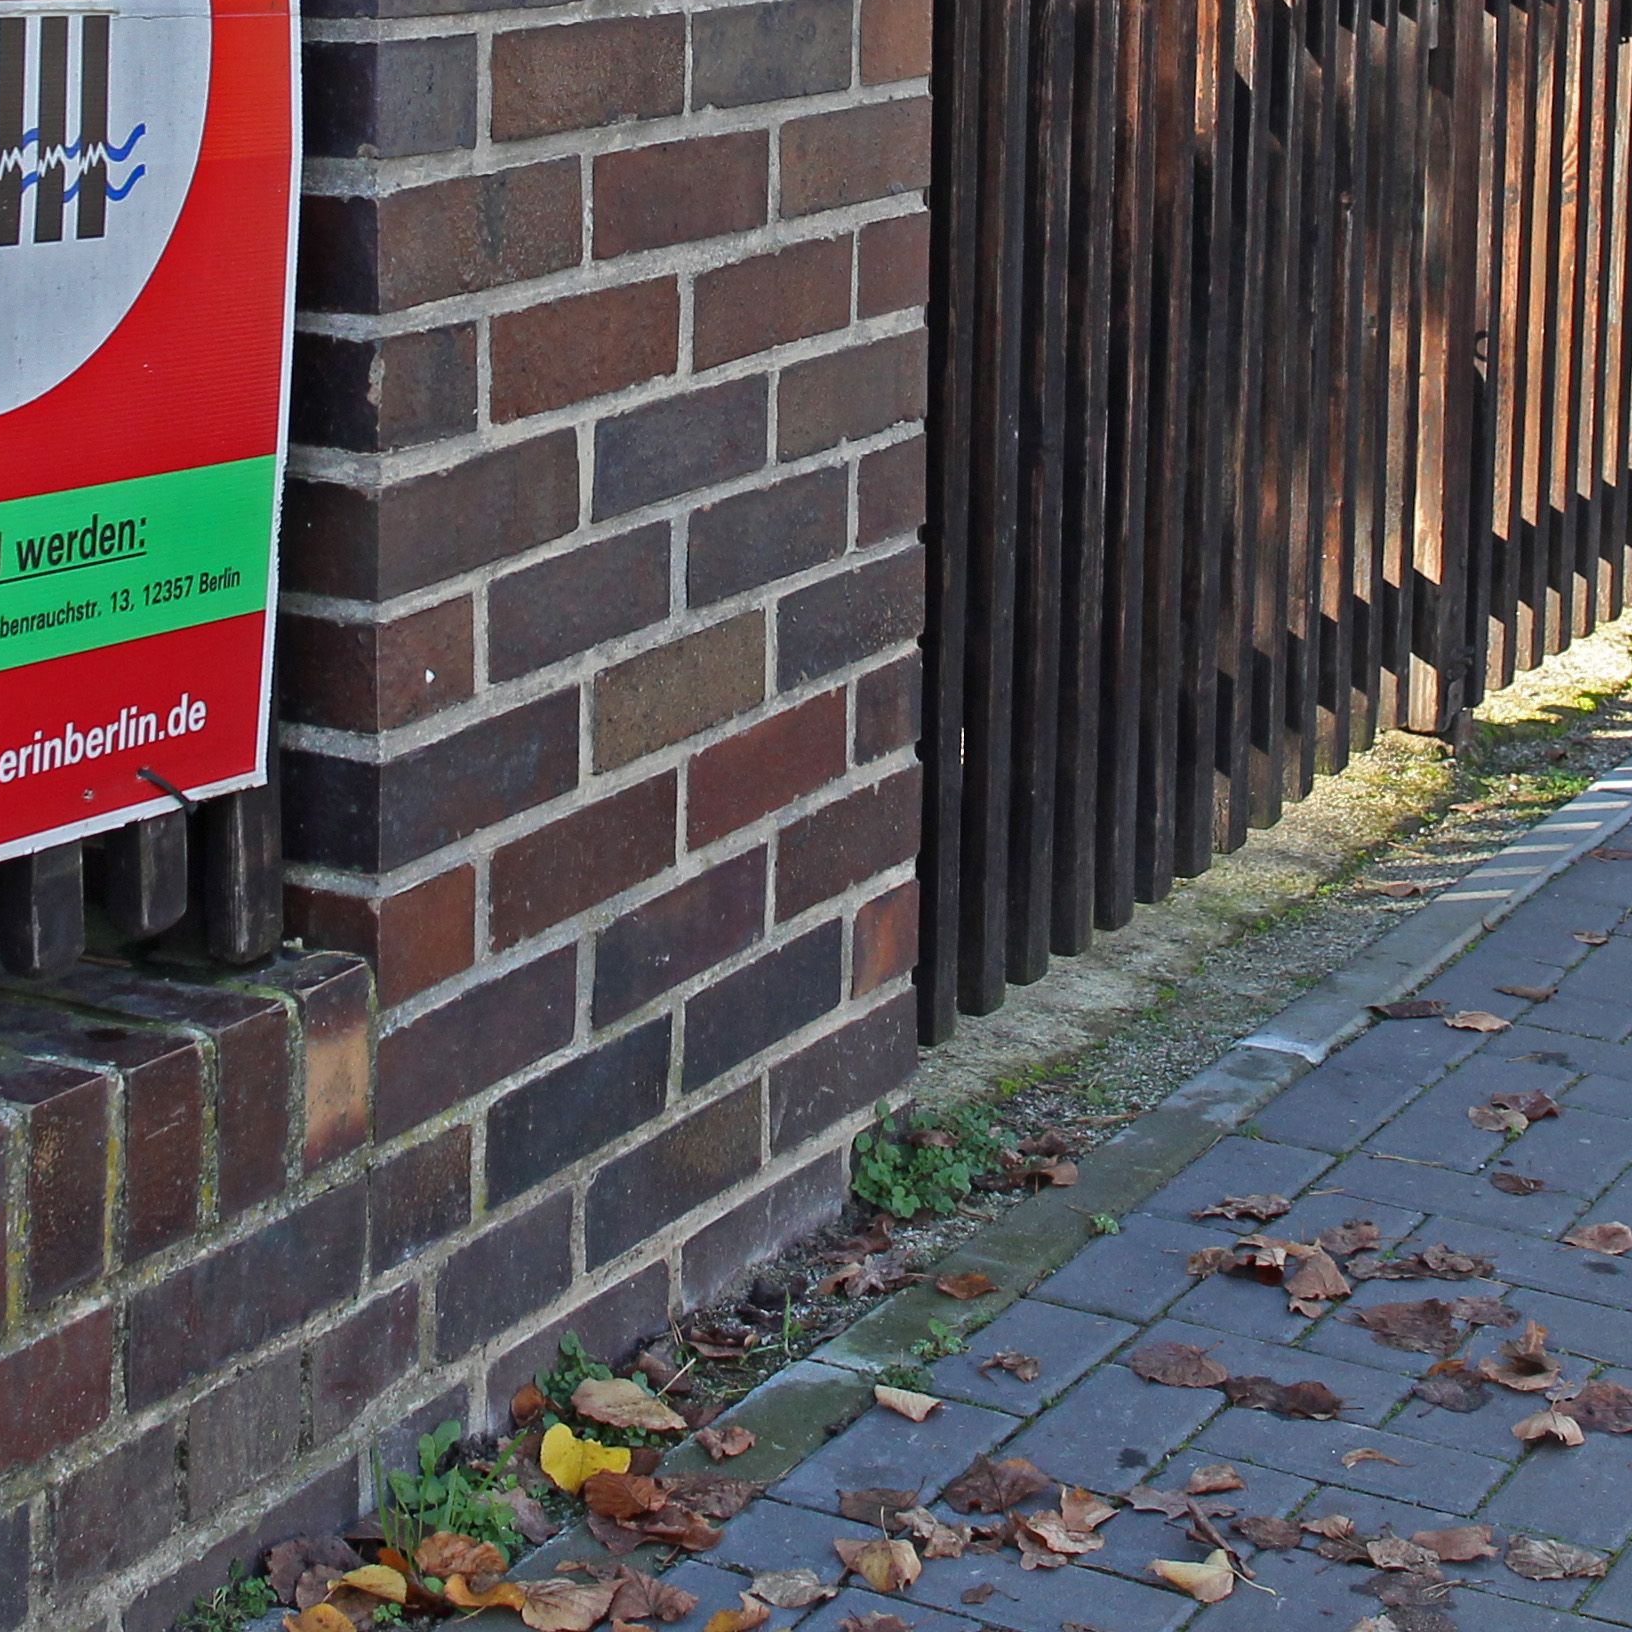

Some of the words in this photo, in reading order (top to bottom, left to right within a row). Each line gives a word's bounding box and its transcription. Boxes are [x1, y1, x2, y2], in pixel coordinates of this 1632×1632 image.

[16, 514, 147, 572] werden:
[110, 591, 135, 618] 13,
[143, 574, 194, 606] 12357
[199, 567, 241, 594] Berlin
